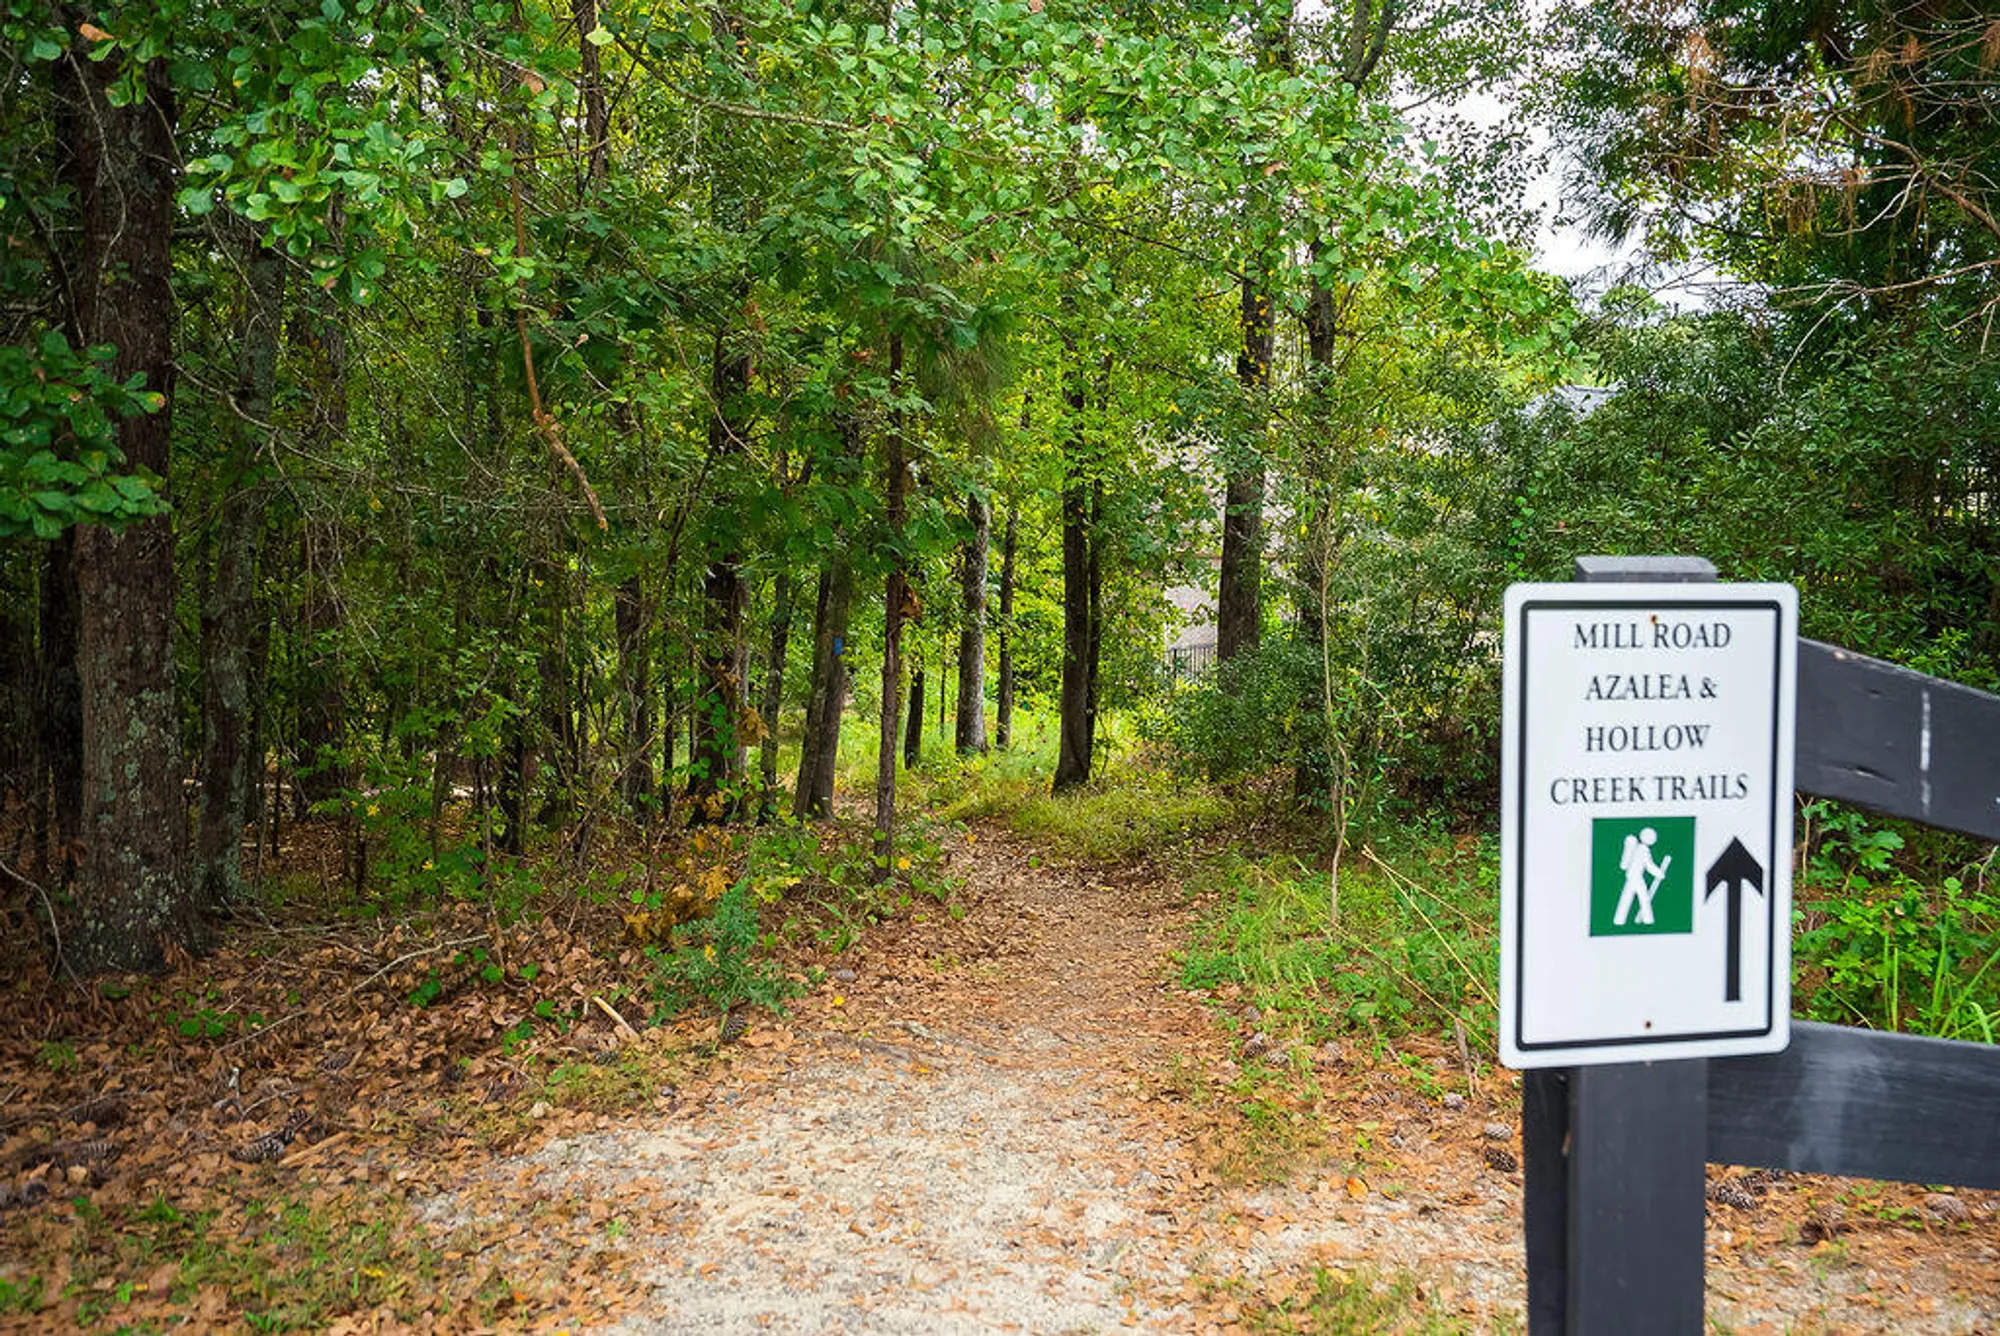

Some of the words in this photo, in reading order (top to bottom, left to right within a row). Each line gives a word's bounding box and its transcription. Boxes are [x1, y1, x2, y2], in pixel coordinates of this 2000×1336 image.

[1574, 624, 1643, 649] MILL
[1653, 623, 1731, 649] ROAD
[1585, 674, 1692, 700] AZALEA
[1699, 677, 1717, 699] &
[1586, 724, 1710, 752] HOLLOW
[1550, 777, 1645, 805] CREEK
[1655, 773, 1748, 801] TRAILS
